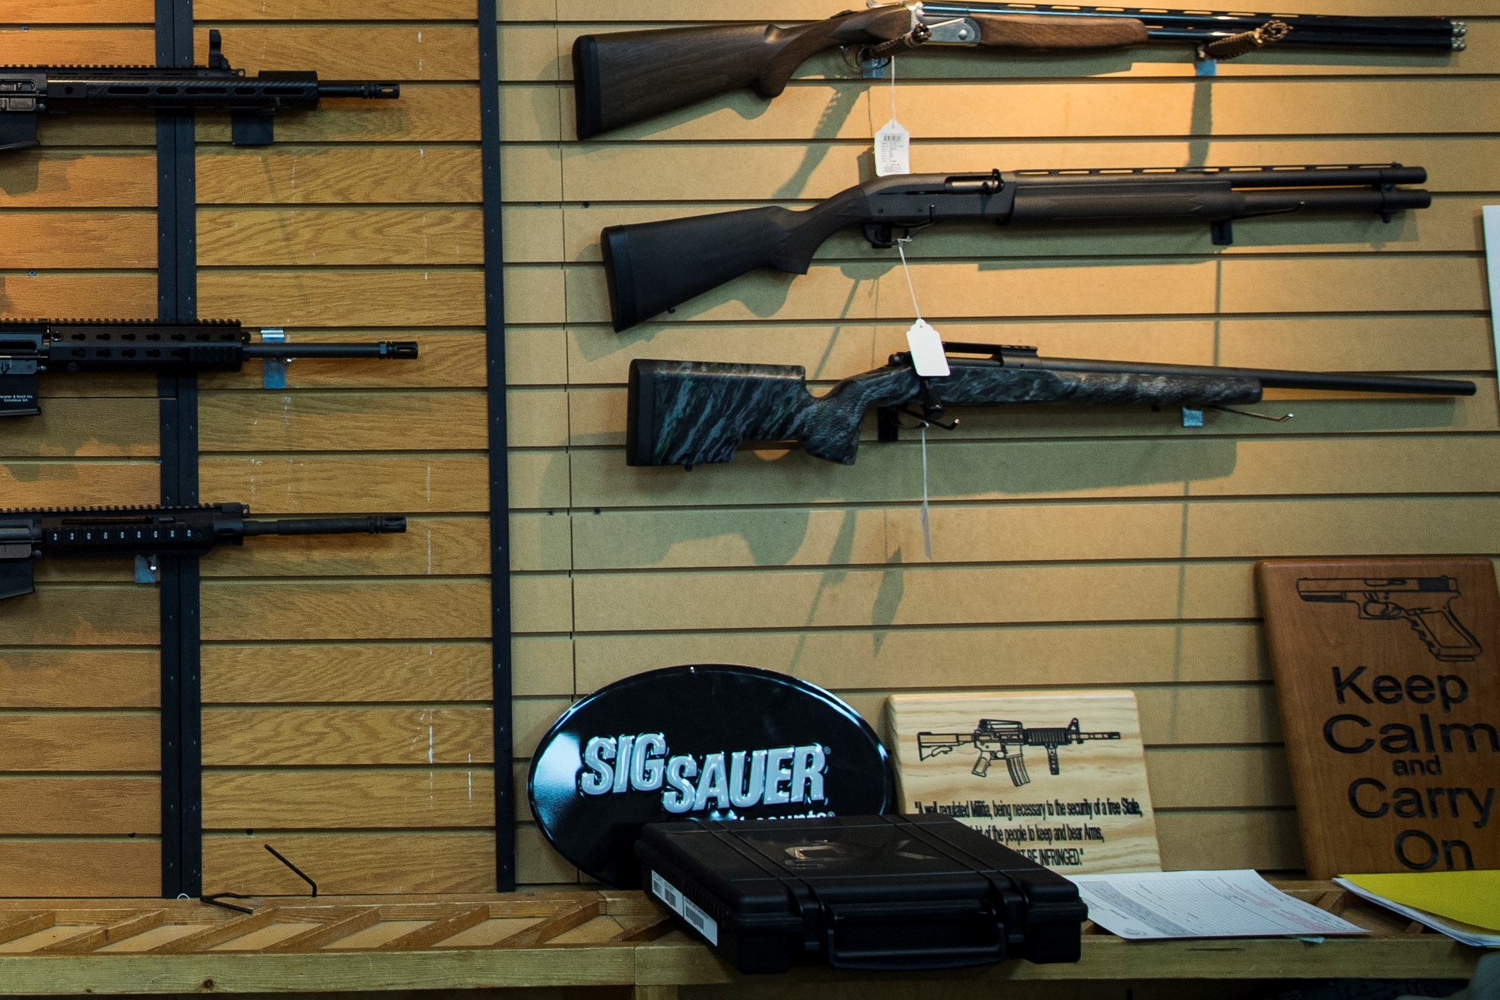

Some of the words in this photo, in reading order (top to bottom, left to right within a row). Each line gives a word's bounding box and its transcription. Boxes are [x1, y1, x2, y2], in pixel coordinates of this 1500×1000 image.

[1332, 665, 1469, 713] Keep
[1323, 714, 1500, 754] Calm
[580, 732, 668, 796] SIG
[1392, 755, 1441, 776] and
[992, 800, 1012, 821] being
[1013, 803, 1045, 820] necessary
[1046, 801, 1053, 816] to
[1055, 800, 1066, 815] the
[1067, 798, 1093, 819] security
[1094, 799, 1101, 814] of
[1101, 804, 1106, 814] a
[1107, 798, 1121, 814] free
[1347, 777, 1495, 829] Carry
[992, 824, 1004, 841] the
[1005, 825, 1027, 846] people
[1027, 824, 1035, 841] to
[1035, 824, 1052, 846] keep
[1053, 824, 1067, 841] and
[1069, 824, 1083, 841] bear
[1394, 829, 1474, 870] On
